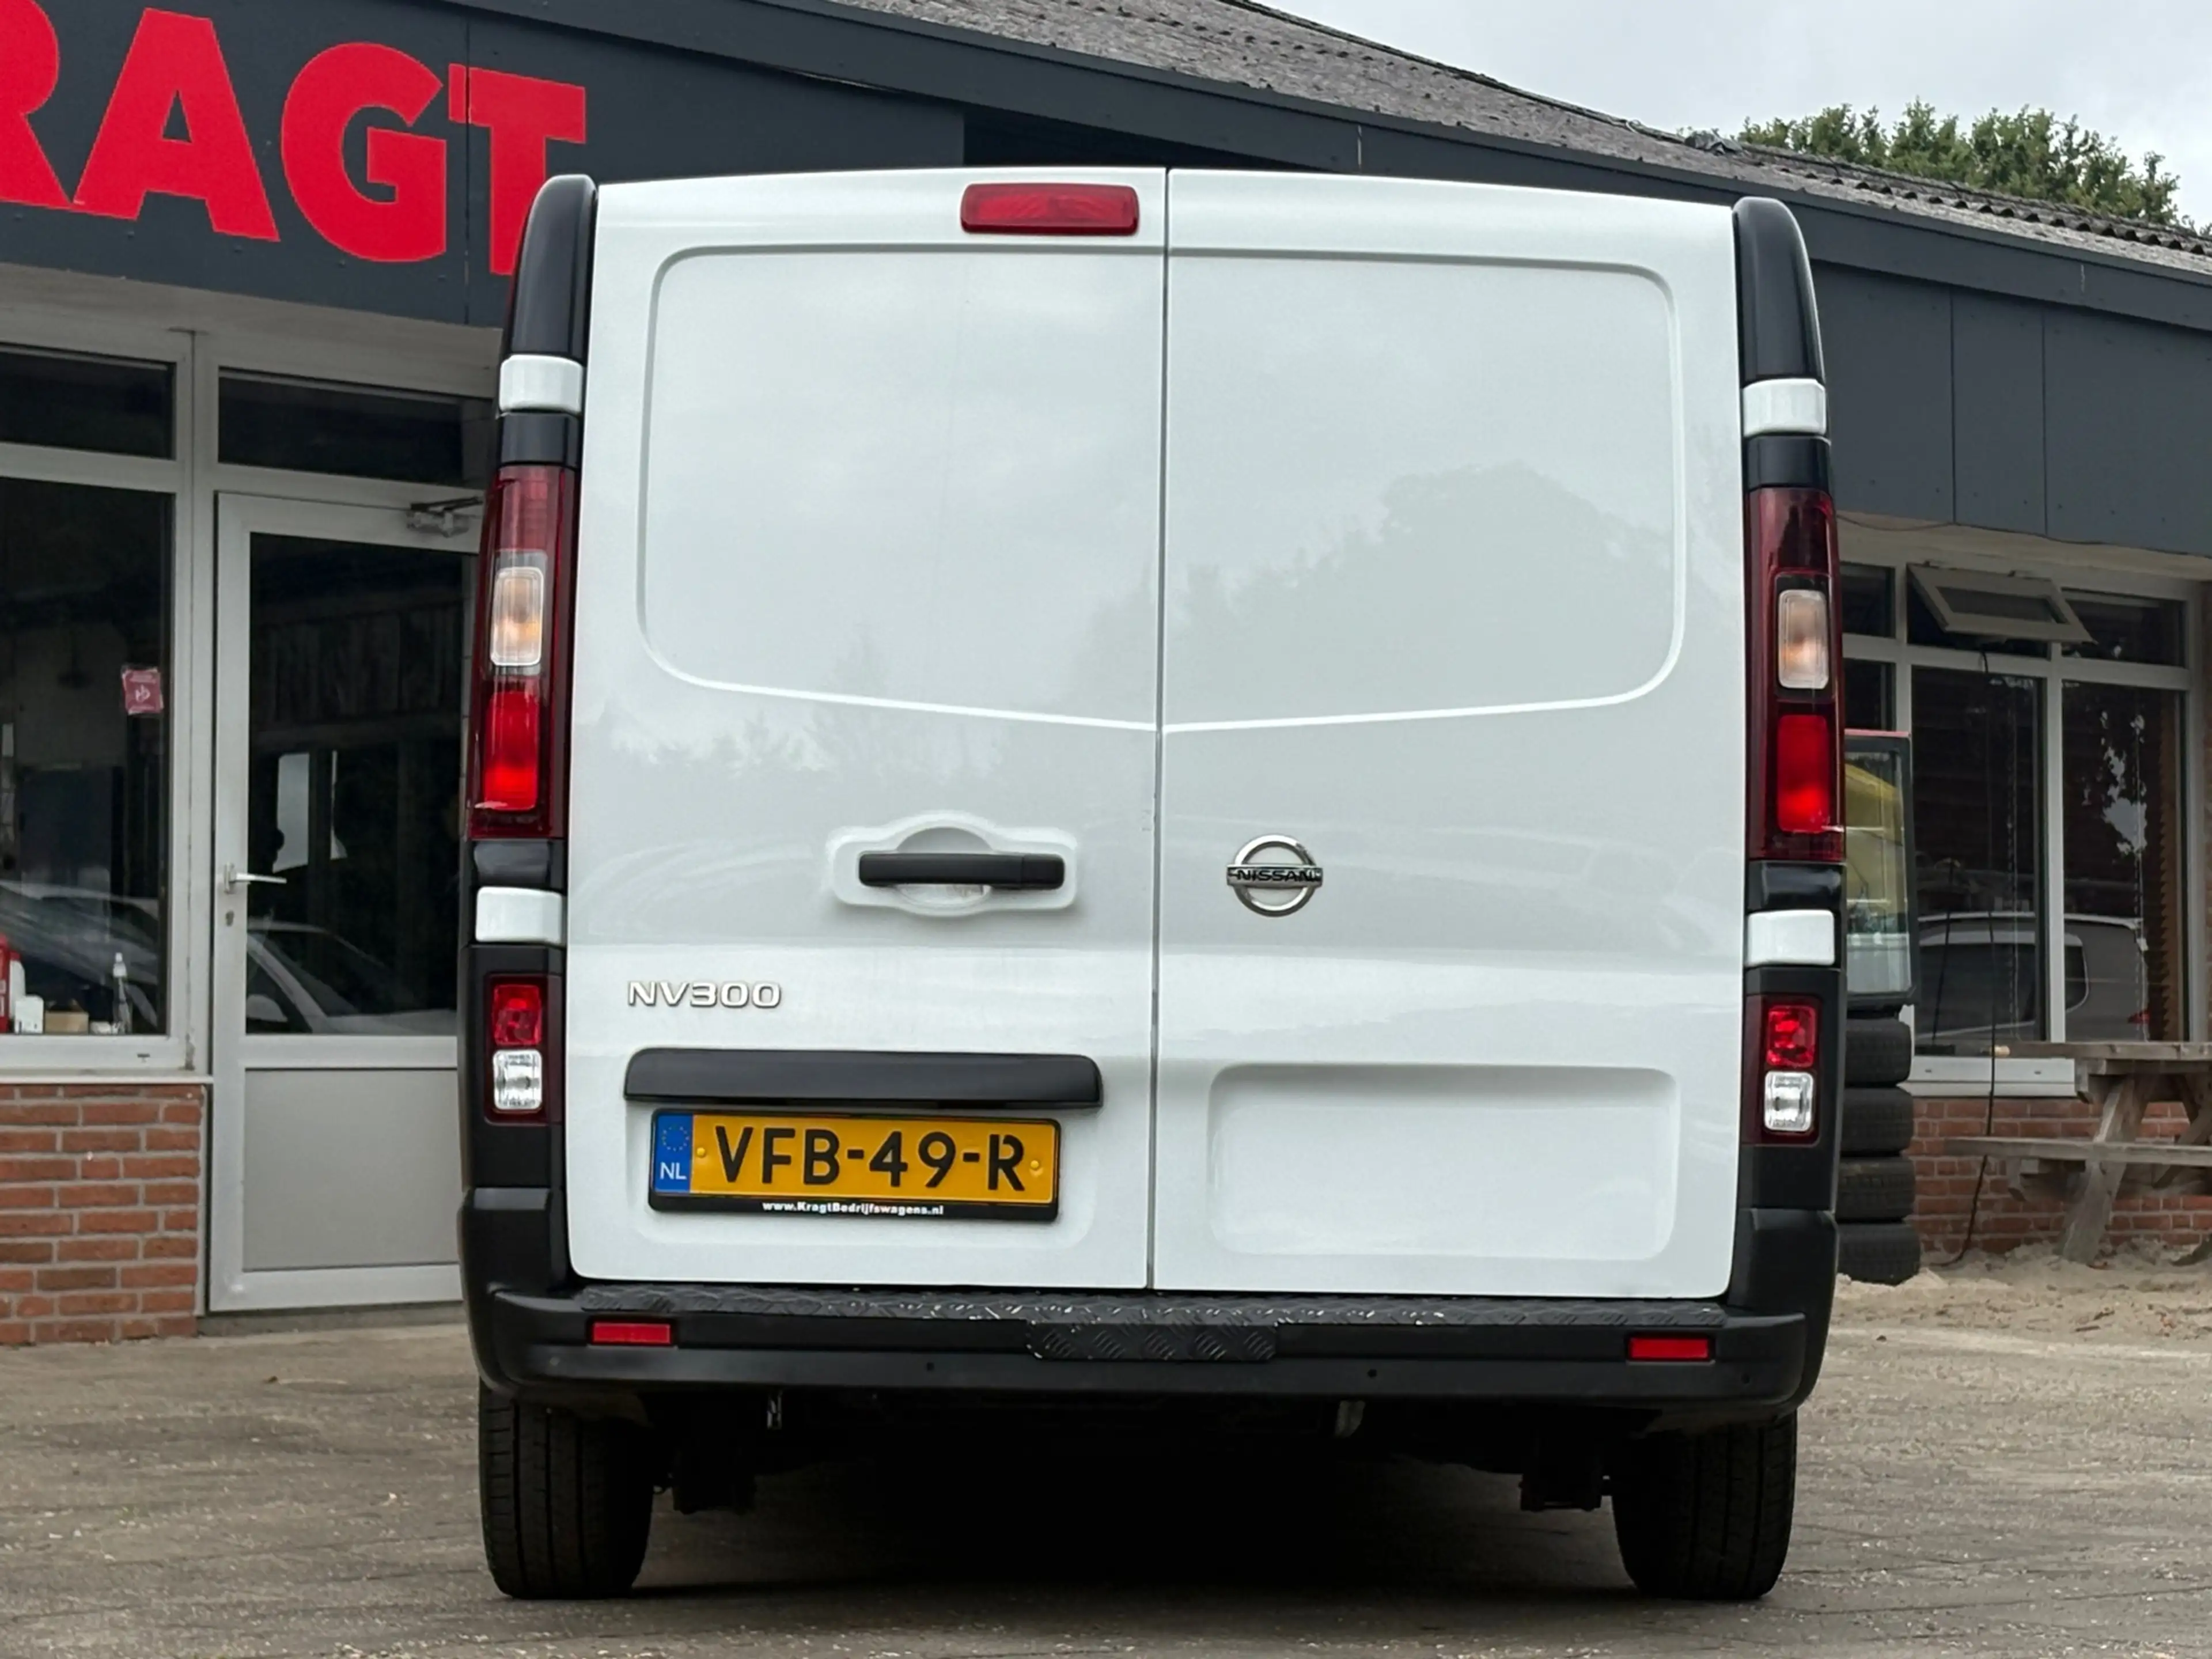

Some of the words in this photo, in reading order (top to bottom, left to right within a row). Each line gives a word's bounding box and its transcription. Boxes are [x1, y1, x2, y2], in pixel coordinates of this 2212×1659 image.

[1237, 869, 1315, 882] NISSAN
[628, 980, 781, 1009] NV300
[660, 1161, 687, 1180] NL
[715, 1126, 1025, 1192] VFB-49-R
